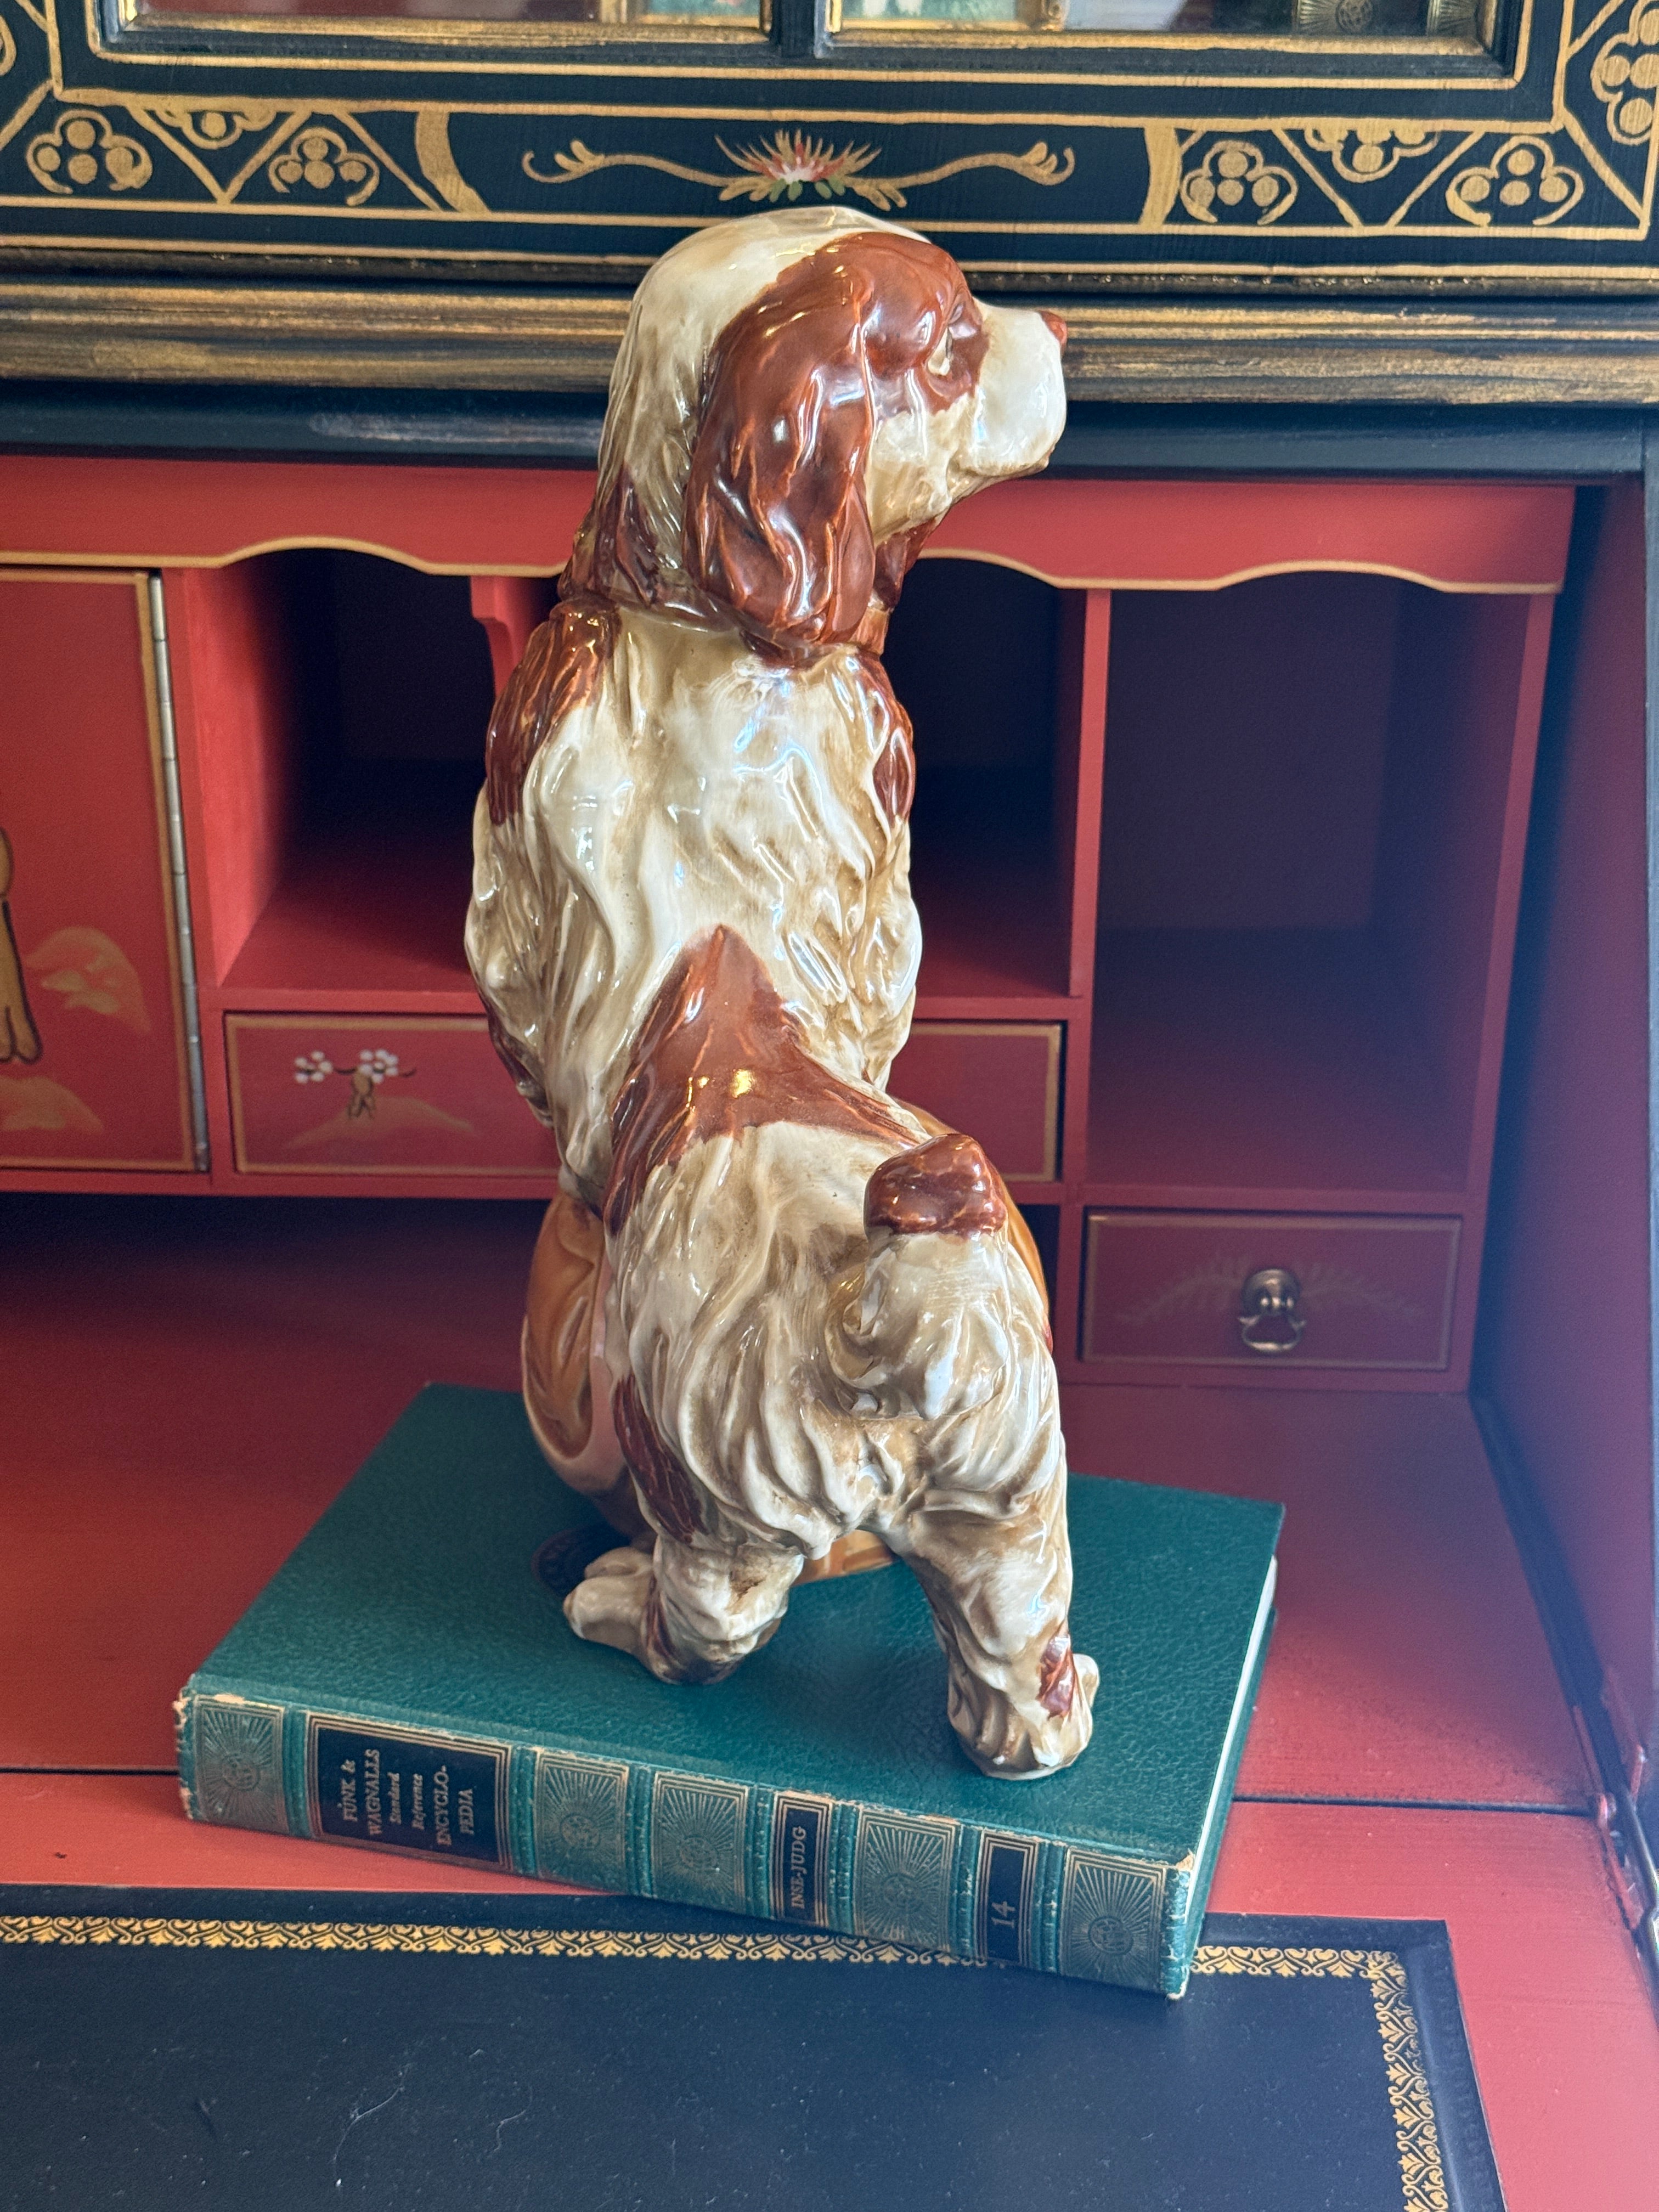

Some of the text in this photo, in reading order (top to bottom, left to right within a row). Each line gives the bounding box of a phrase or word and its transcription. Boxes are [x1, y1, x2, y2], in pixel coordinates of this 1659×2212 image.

[341, 1759, 358, 1821] FUNK &
[365, 1749, 381, 1835] WAGNALLS
[387, 1772, 401, 1825] Standard
[411, 1773, 425, 1830] Reference
[434, 1765, 452, 1846] ENCYCLO-
[458, 1788, 474, 1835] PEDIA
[791, 1826, 807, 1909] INSE-JUDG
[991, 1901, 1015, 1928] 14
